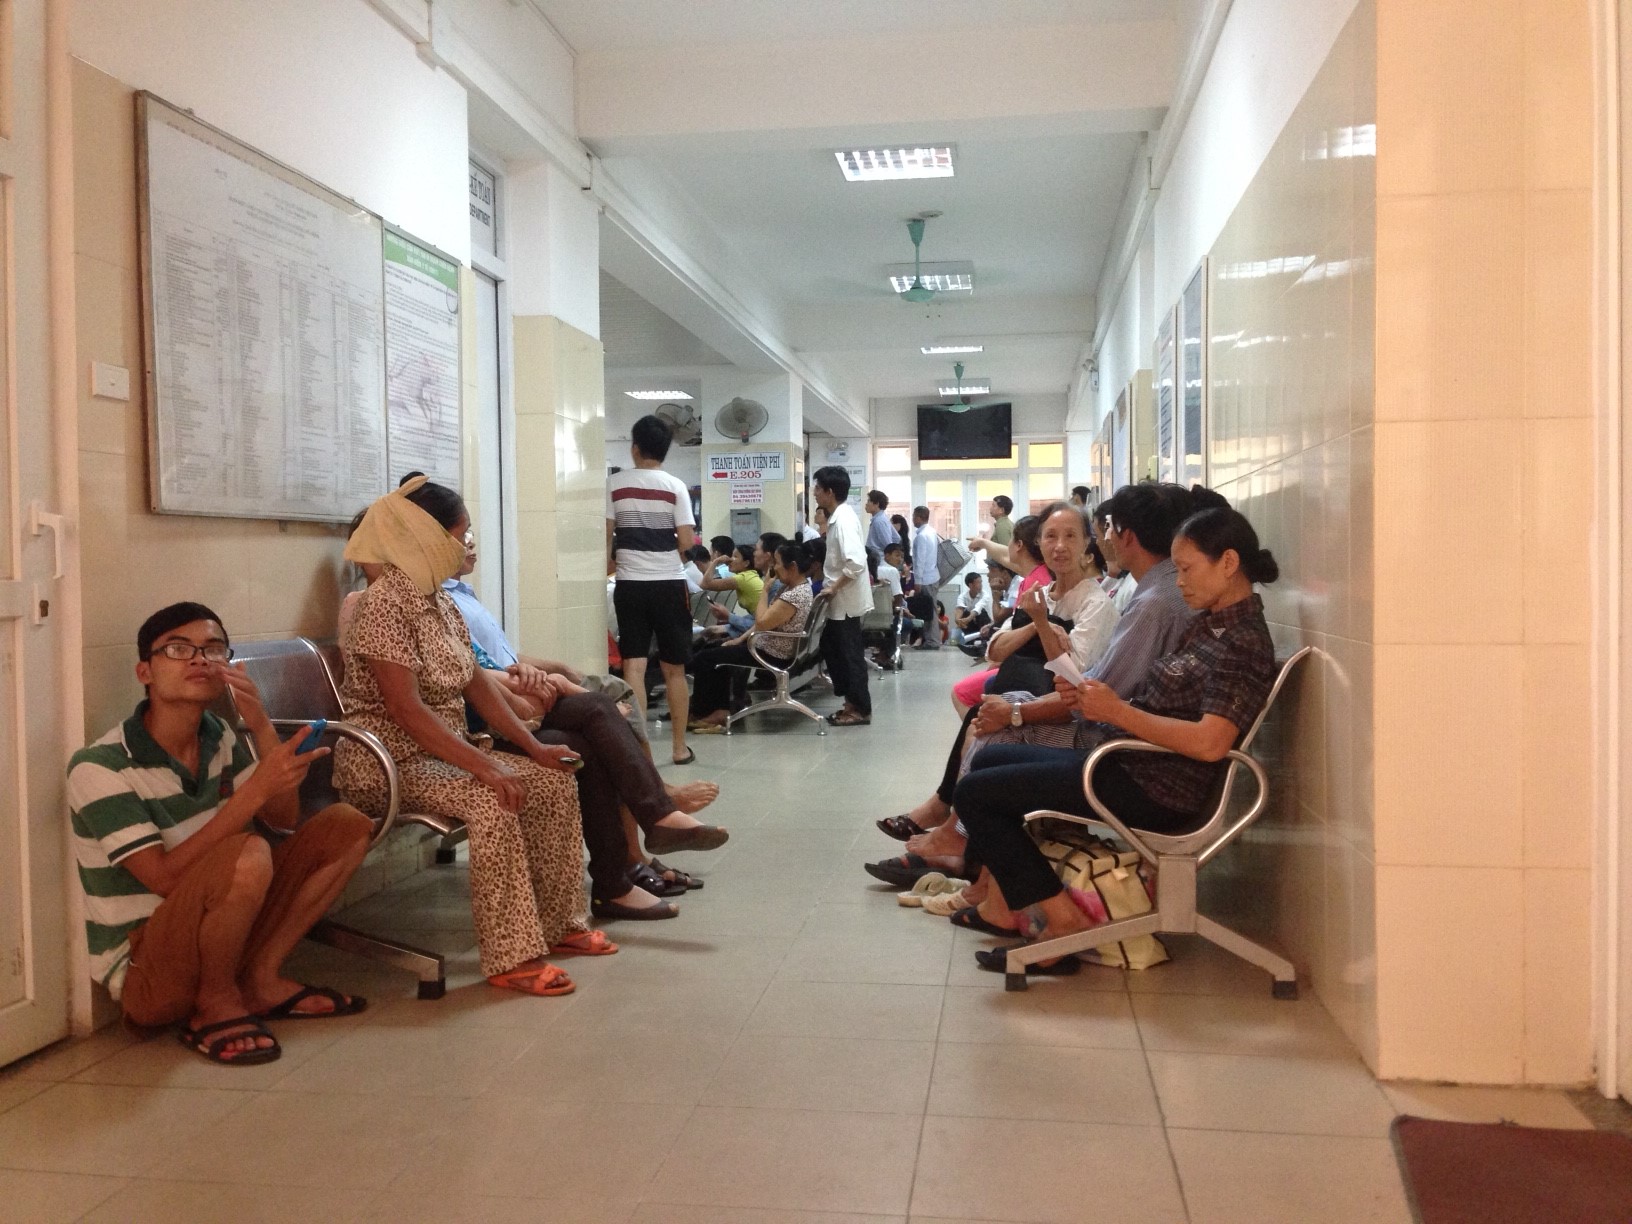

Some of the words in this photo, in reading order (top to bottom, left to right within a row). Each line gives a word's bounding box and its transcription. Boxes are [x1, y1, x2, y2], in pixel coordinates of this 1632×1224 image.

[711, 457, 733, 470] THANH
[734, 454, 751, 469] TOÁN
[752, 453, 768, 471] VIỆN
[769, 452, 781, 469] PHÍ
[730, 470, 762, 480] E.205
